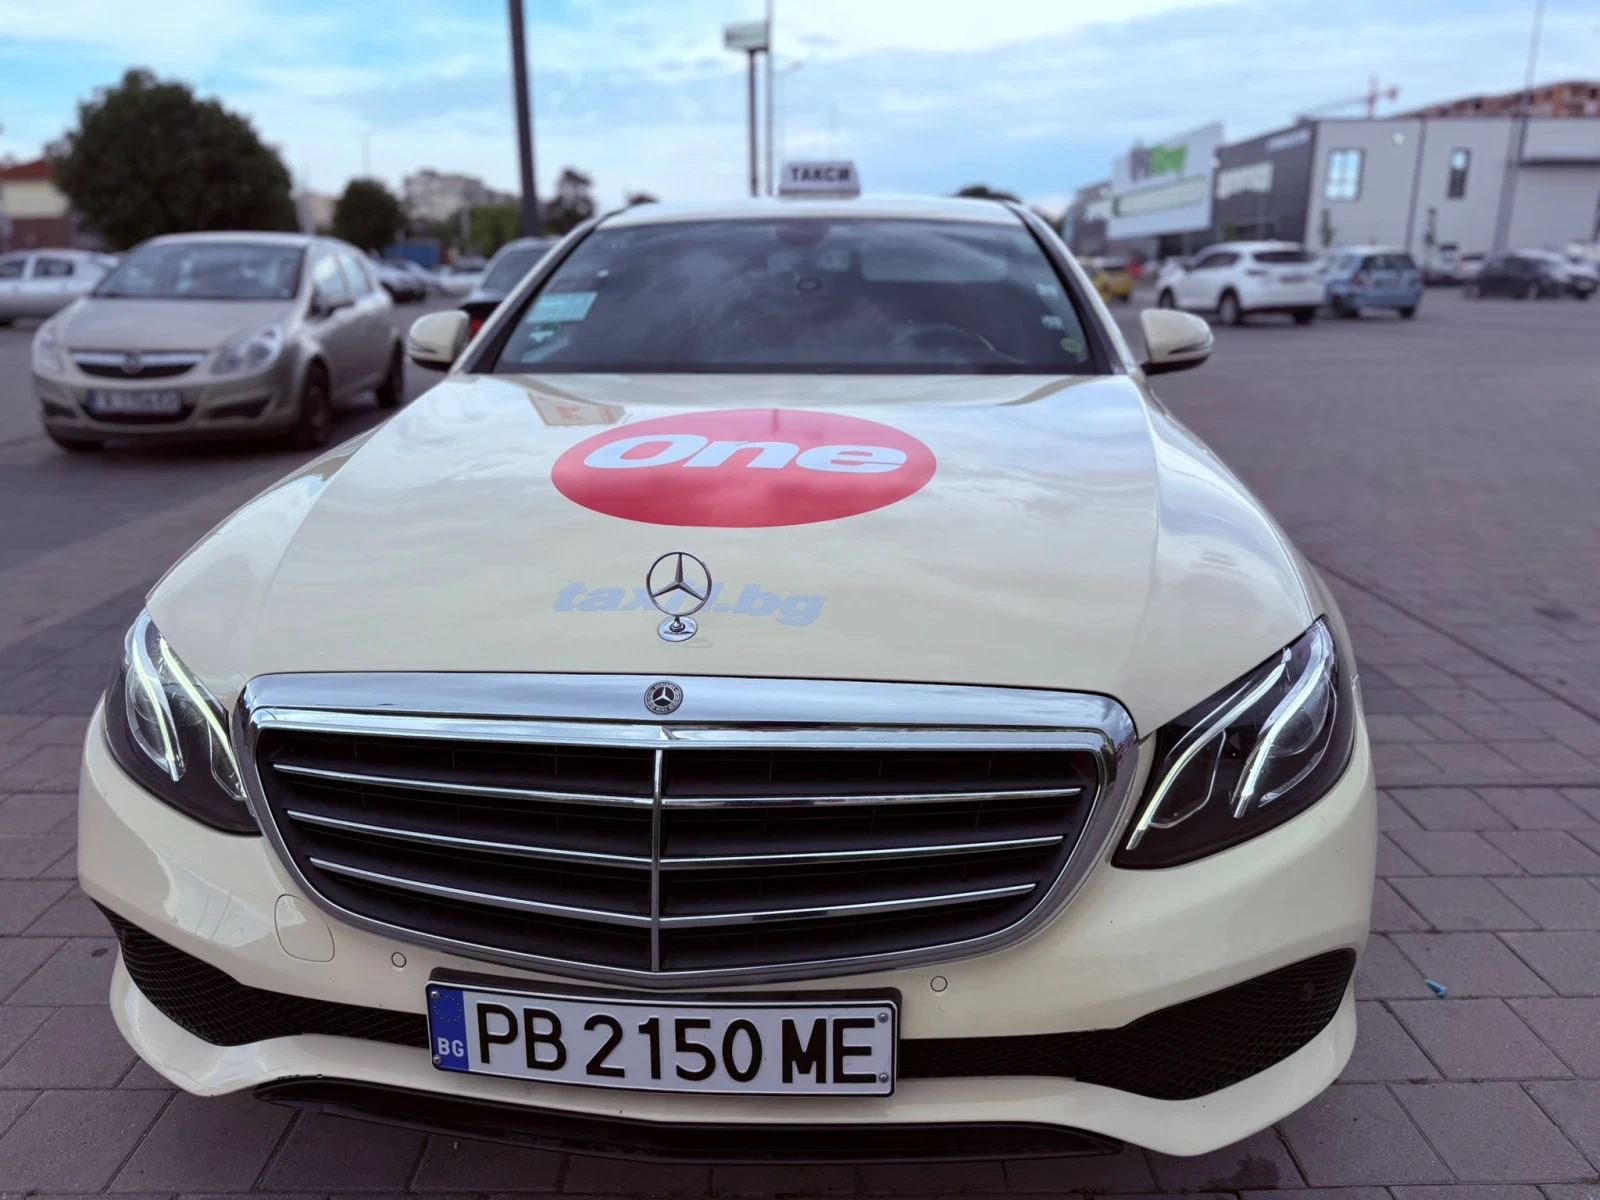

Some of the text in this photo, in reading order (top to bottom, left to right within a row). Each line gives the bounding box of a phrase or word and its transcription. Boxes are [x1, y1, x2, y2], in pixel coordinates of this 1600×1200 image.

[583, 433, 907, 474] One
[437, 1037, 465, 1058] BG
[476, 1002, 877, 1084] PB 2150 ME
